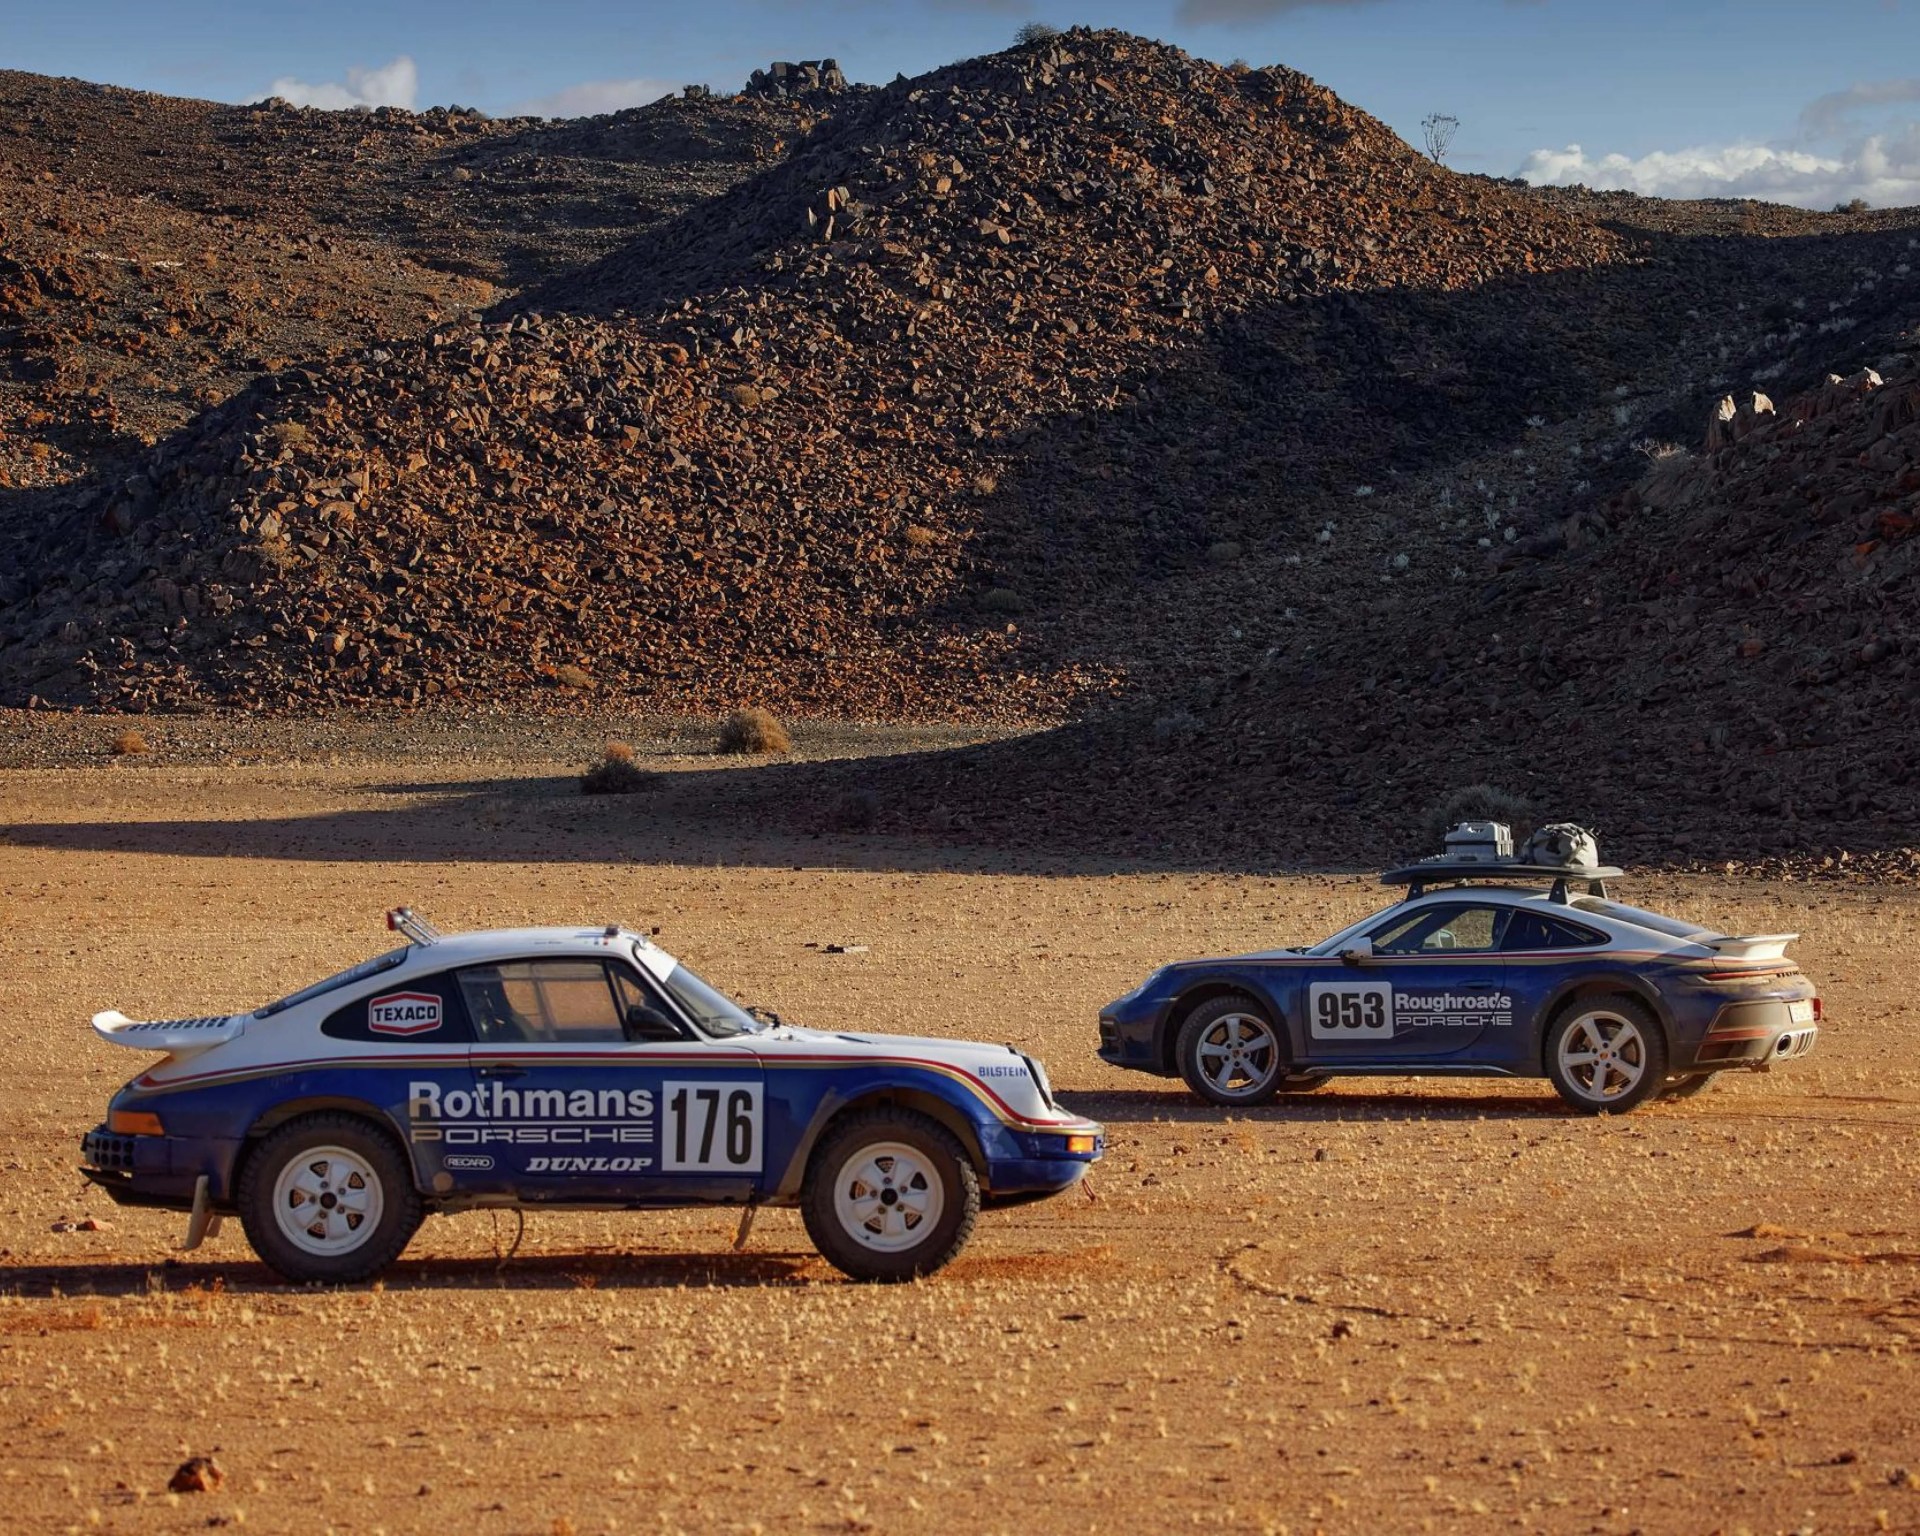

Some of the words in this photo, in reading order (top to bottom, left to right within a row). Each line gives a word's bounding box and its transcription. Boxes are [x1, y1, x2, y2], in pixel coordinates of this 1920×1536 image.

[1395, 992, 1512, 1012] Roughroads
[374, 1005, 437, 1022] TEXACO
[1318, 992, 1385, 1029] 953
[1396, 1016, 1512, 1026] PORSCHE
[978, 1066, 1028, 1077] BILSTEIN
[409, 1081, 654, 1118] Rothmans
[671, 1088, 752, 1165] 176
[411, 1128, 653, 1143] PORSCHE
[448, 1158, 490, 1167] RECARO
[526, 1157, 653, 1171] DUNLOP
